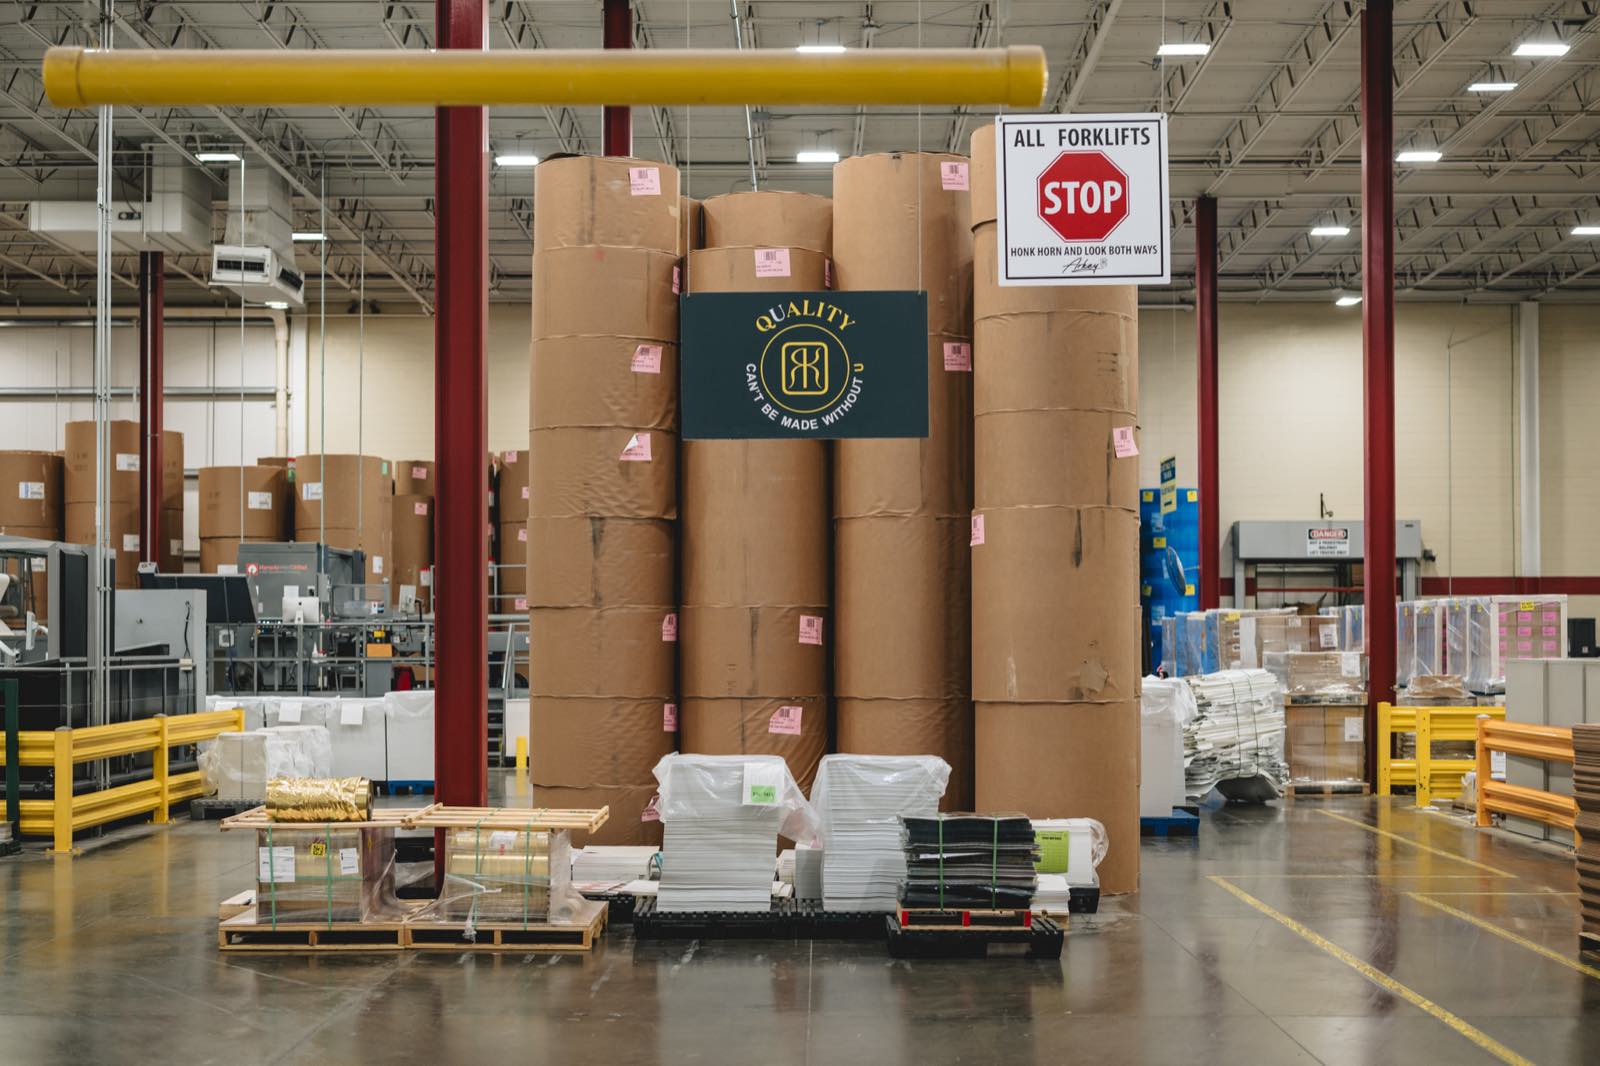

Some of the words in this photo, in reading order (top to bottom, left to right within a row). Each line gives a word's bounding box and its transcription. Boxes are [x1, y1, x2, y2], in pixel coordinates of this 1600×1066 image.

[1014, 129, 1045, 147] ALL
[1058, 127, 1150, 146] FORKLIFTS
[1044, 180, 1122, 215] STOP
[1010, 247, 1035, 256] HONK
[1037, 247, 1062, 256] HORN
[1064, 246, 1083, 256] AND
[1084, 246, 1107, 255] LOOK
[1109, 245, 1132, 255] BOTH
[1134, 245, 1158, 255] WAYS
[756, 300, 856, 333] QUALITY
[746, 363, 764, 403] CAN'T
[761, 403, 779, 421] BE
[780, 415, 819, 430] MADE
[821, 376, 863, 426] WITHOUT
[853, 363, 864, 372] U
